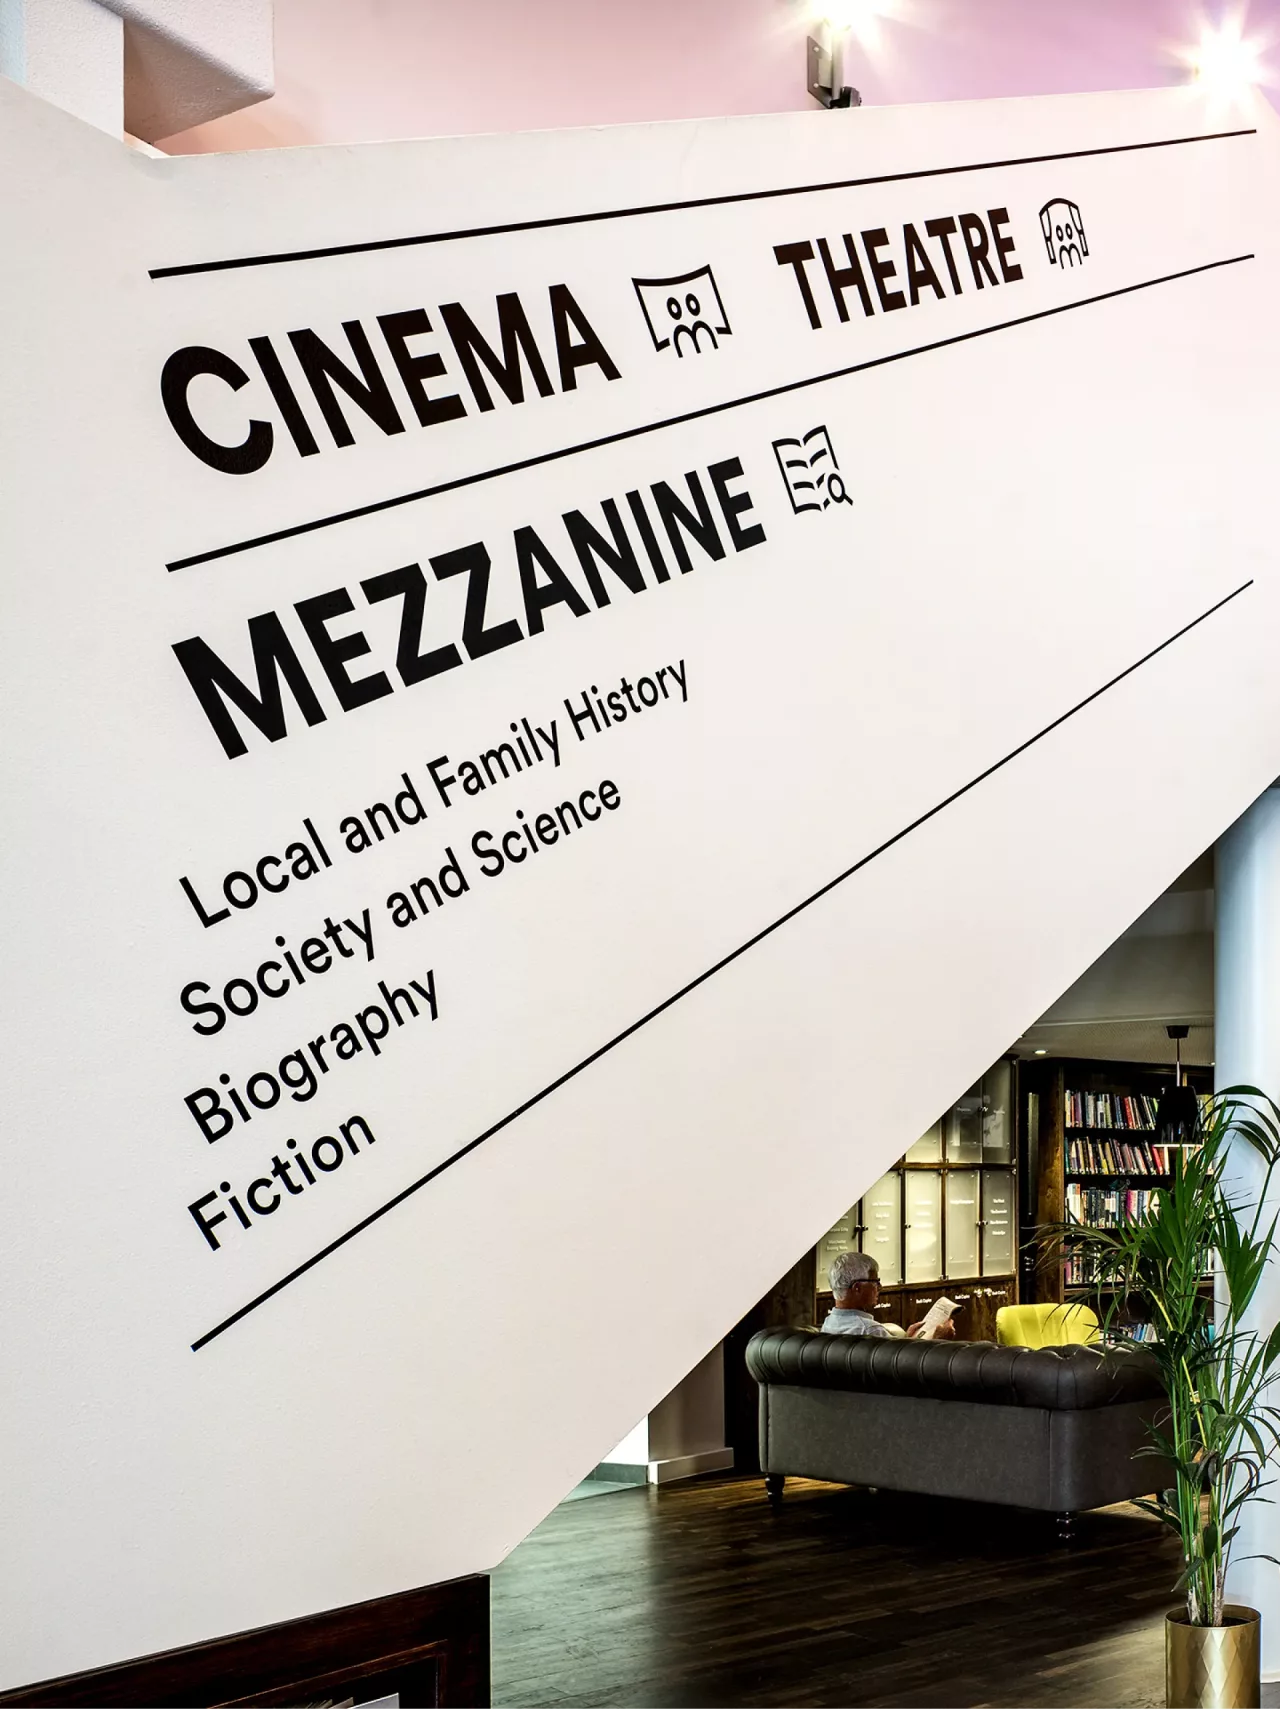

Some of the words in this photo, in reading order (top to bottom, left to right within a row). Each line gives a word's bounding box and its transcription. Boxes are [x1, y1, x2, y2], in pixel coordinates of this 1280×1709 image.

[160, 283, 623, 475] CINEMA
[772, 207, 1024, 331] THEATRE
[170, 456, 768, 760] MEZZANINE
[178, 817, 333, 929] Local
[339, 772, 428, 854] and
[426, 716, 563, 836] Family
[564, 659, 691, 742] History
[180, 908, 377, 1037] Society
[386, 846, 471, 929] and
[471, 779, 622, 878] Science
[183, 969, 440, 1146] Biography
[187, 1114, 377, 1252] Fiction
